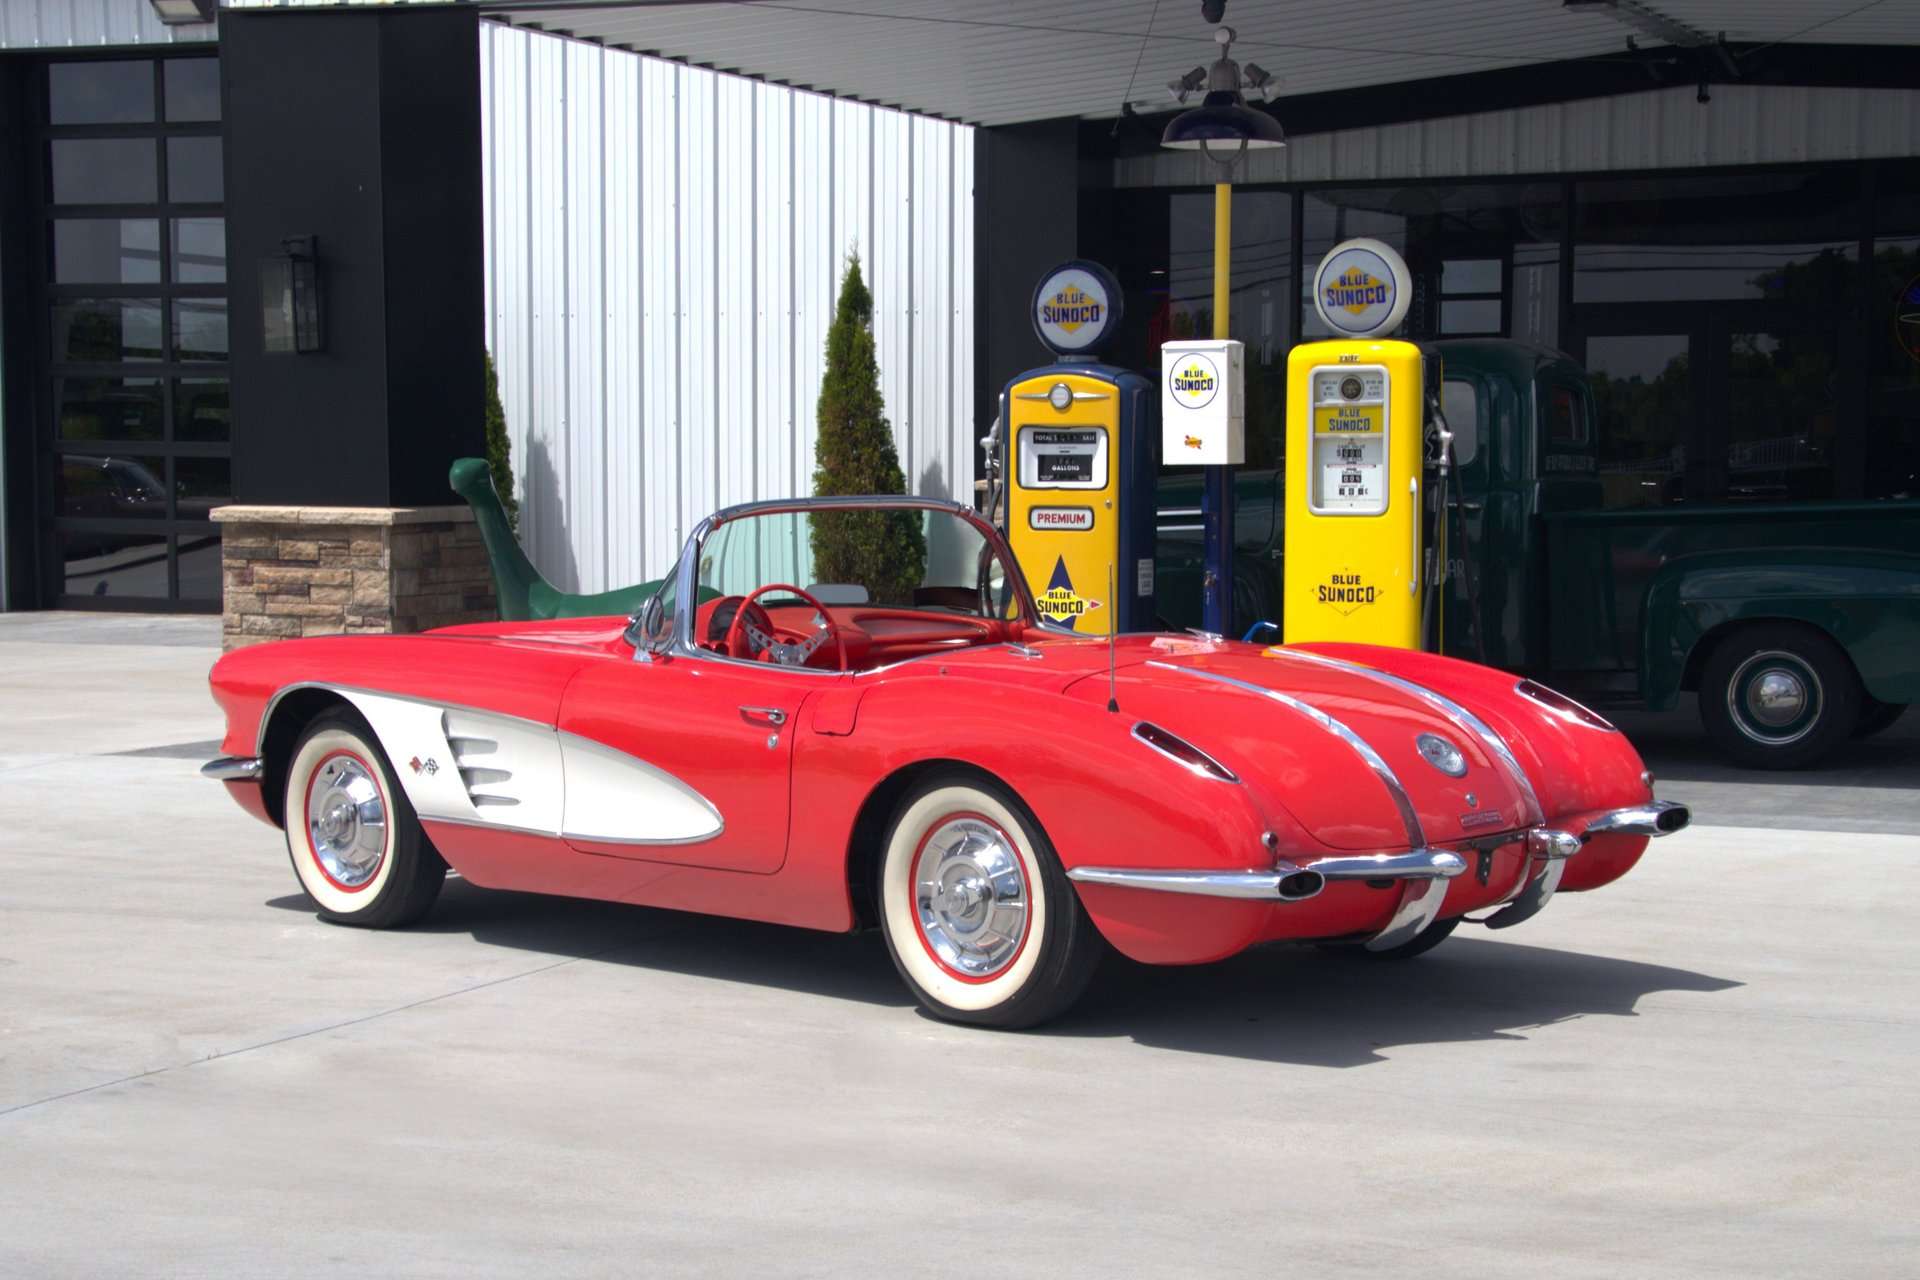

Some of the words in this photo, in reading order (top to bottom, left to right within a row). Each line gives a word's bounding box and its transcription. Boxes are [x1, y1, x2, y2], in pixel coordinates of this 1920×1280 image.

[1339, 273, 1369, 287] BLUE
[1056, 292, 1085, 303] BLUE
[1326, 285, 1386, 306] SUNOCO
[1043, 305, 1100, 324] SUNOCO
[1183, 369, 1204, 378] BLUE
[1174, 378, 1214, 391] SUNOCO
[1338, 407, 1361, 418] BLUE
[1329, 418, 1371, 432] SUNOCO
[1037, 512, 1085, 524] PREMIUM
[1332, 574, 1361, 585] BLUE
[1048, 592, 1072, 600] BLUE
[1318, 585, 1375, 603] SUNOCO
[1037, 600, 1084, 614] SUNOCO
